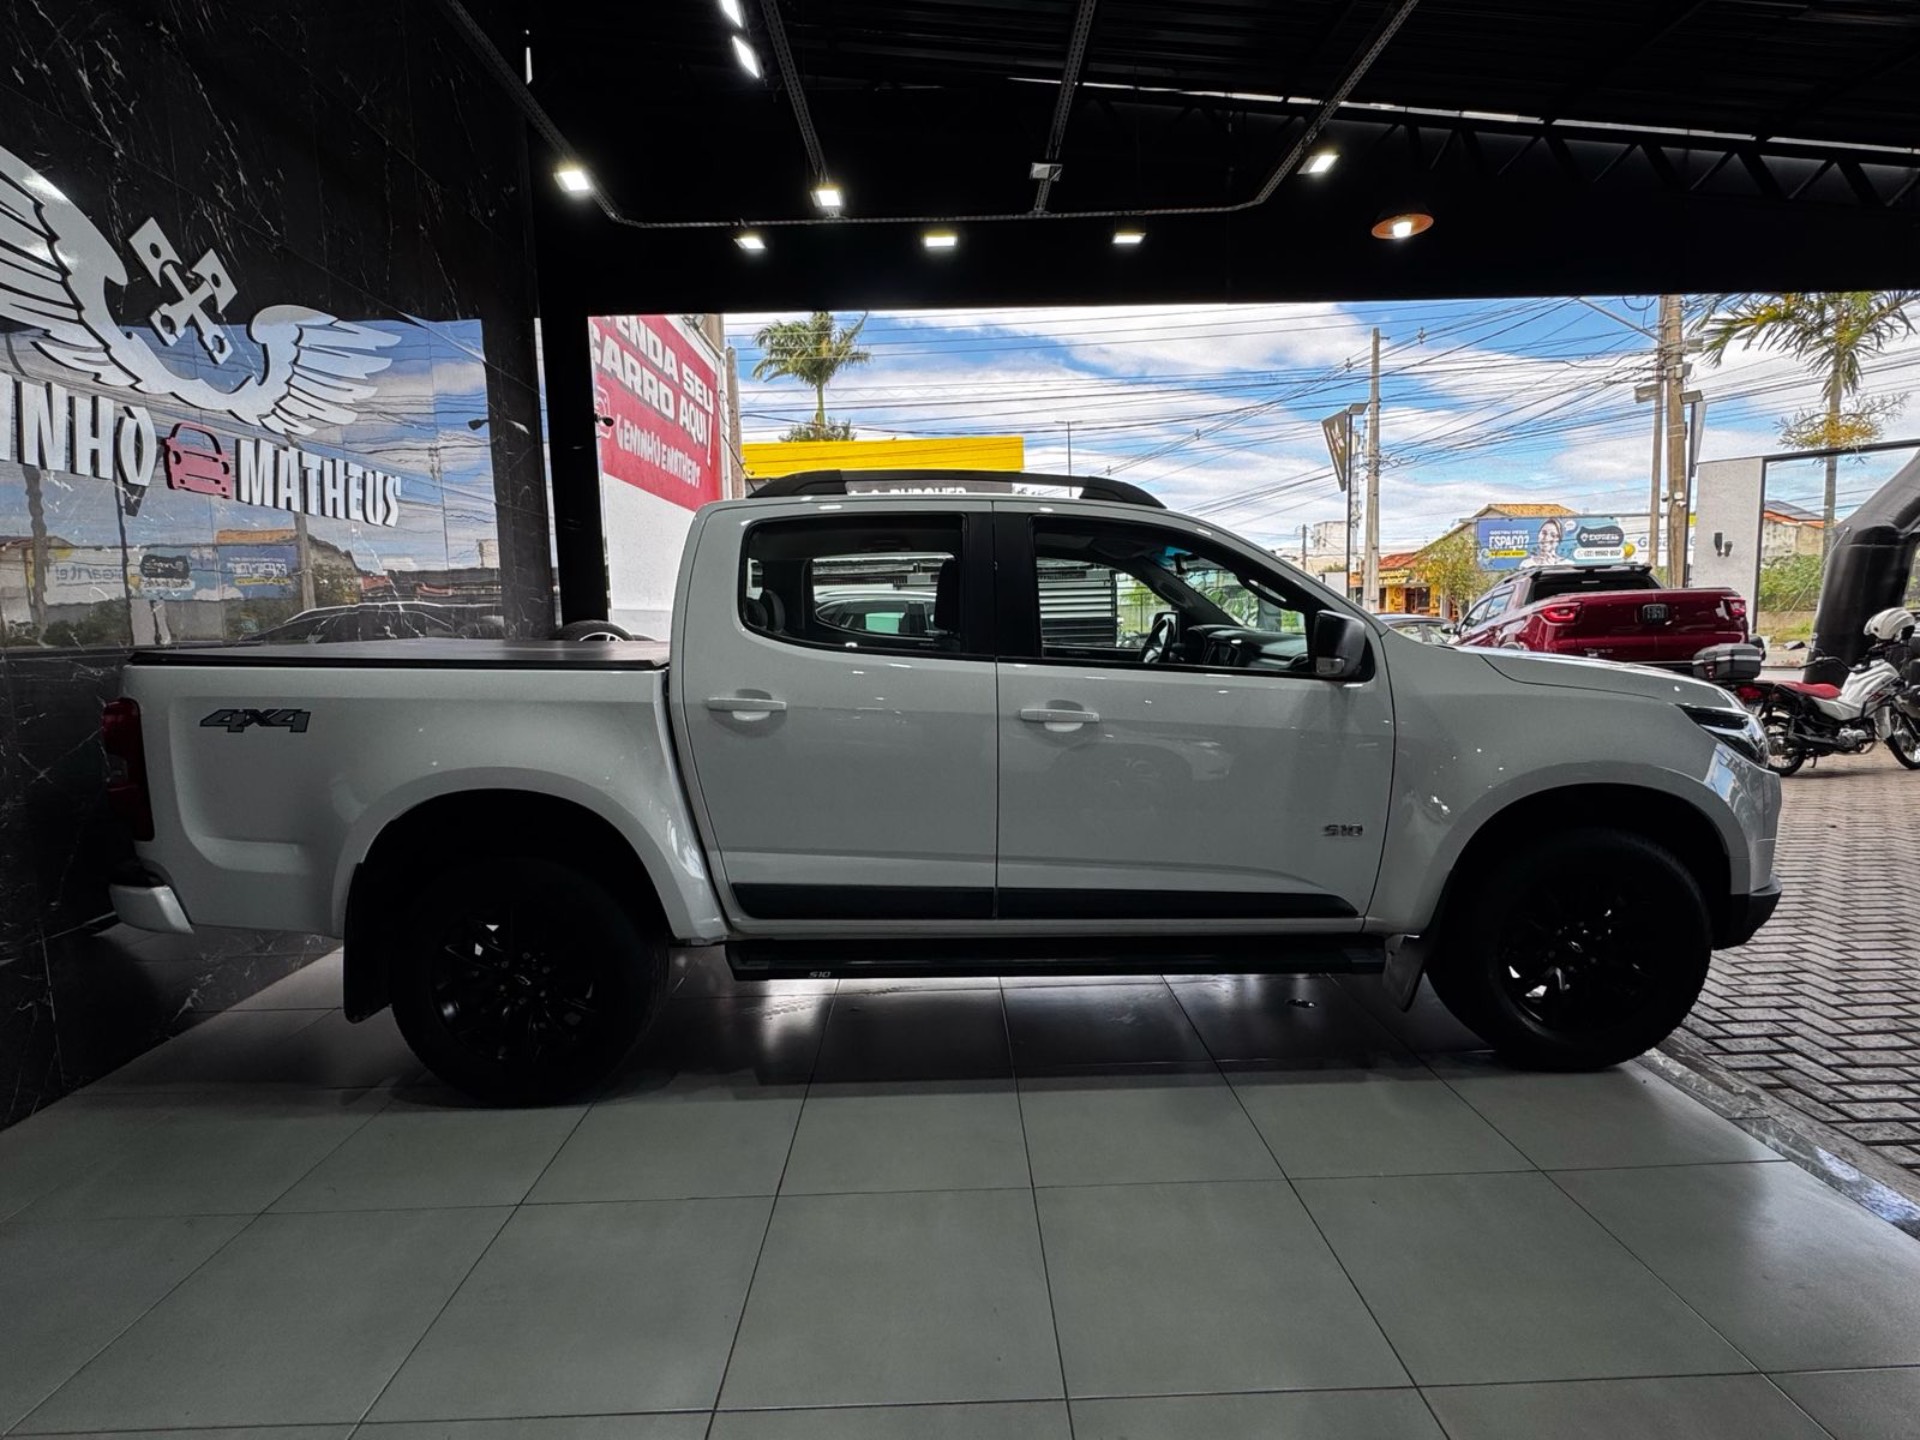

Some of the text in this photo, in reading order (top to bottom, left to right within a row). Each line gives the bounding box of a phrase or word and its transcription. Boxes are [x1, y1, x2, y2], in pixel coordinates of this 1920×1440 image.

[607, 316, 714, 415] ENDA SEU
[234, 438, 402, 528] MATHEUS
